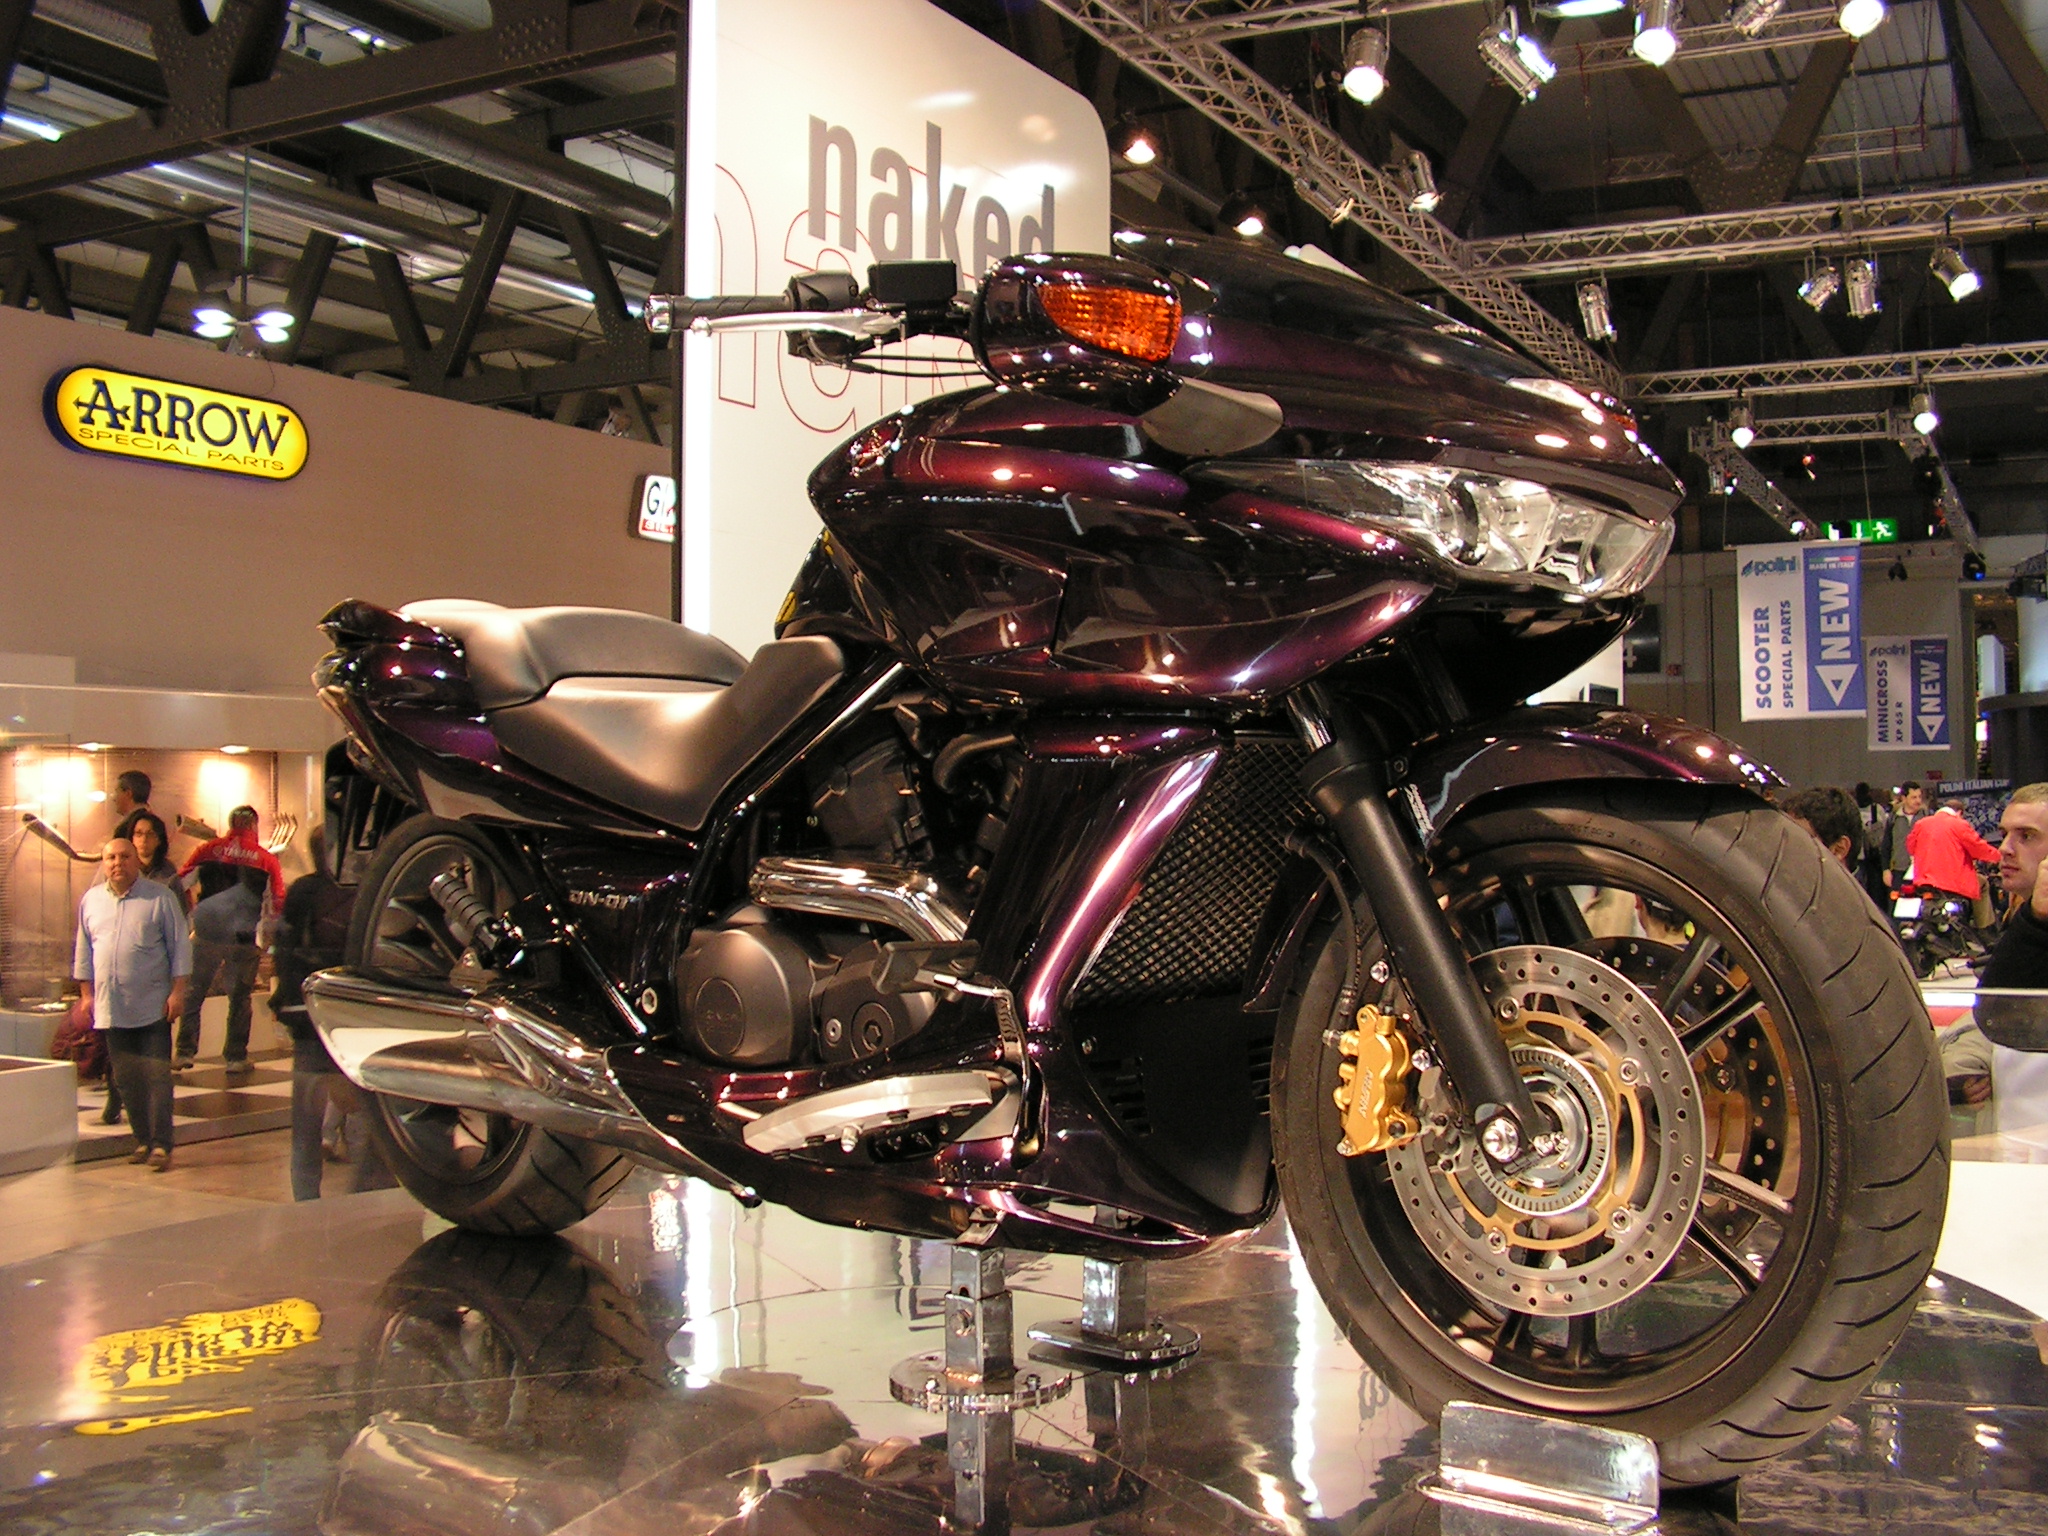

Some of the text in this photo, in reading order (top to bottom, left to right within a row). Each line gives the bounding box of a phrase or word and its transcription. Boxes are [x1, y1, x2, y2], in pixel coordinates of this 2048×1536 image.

[808, 113, 1055, 291] naked
[72, 378, 289, 456] ARROW
[78, 427, 284, 471] SPECIAL PARTS
[1754, 556, 1797, 576] polini
[1754, 606, 1771, 709] SCOOTER
[1780, 600, 1794, 708] SPECIAL PARTS
[1819, 578, 1851, 660] NEW
[1877, 660, 1888, 742] MINICROSS
[1920, 659, 1941, 713] NEW
[1896, 729, 1903, 742] XP
